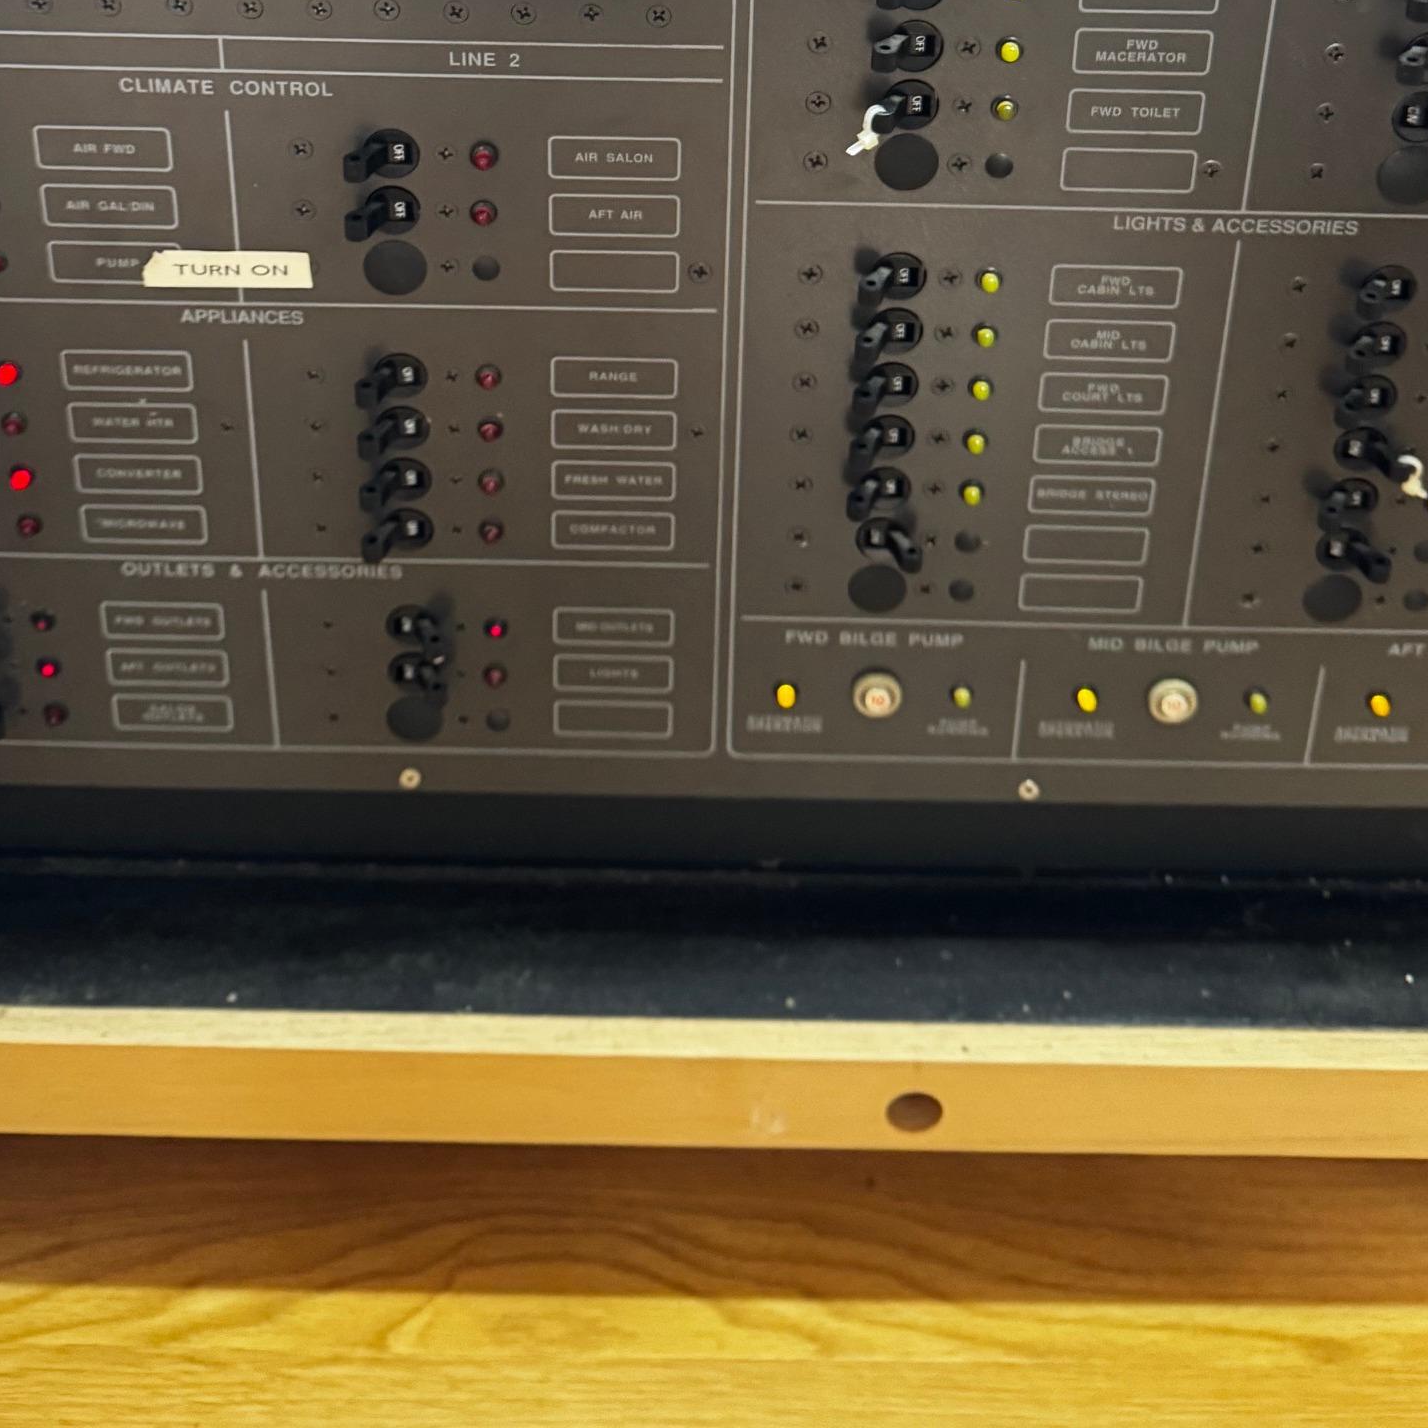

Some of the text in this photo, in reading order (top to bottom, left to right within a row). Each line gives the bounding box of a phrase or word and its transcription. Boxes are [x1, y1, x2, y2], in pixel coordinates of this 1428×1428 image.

[1126, 39, 1158, 50] FWD
[449, 51, 520, 67] LINE 2
[1095, 50, 1186, 63] MACERATOR
[119, 78, 333, 97] CLIMATE CONTROL
[1091, 107, 1180, 118] FWD TOILET
[73, 143, 136, 155] AIR FWD
[575, 151, 653, 163] AIR SALON
[66, 200, 90, 211] AIR
[589, 209, 643, 221] AFT AIR
[1114, 215, 1359, 235] LIGHTS & ACCESSORIES
[95, 257, 140, 268] PUMP
[173, 264, 288, 276] TURN ON
[181, 309, 304, 325] APPLIANCES
[73, 365, 182, 377] REFRIGERATOR
[589, 371, 638, 382] RANGE
[564, 475, 663, 486] FRESH WATER
[121, 562, 215, 578] OUTLETS
[259, 564, 402, 579] ACCESSORIES
[785, 631, 964, 647] FWD BILGE PUMP
[1088, 637, 1258, 653] MID BILGE PUMP
[1388, 643, 1424, 657] AFT
